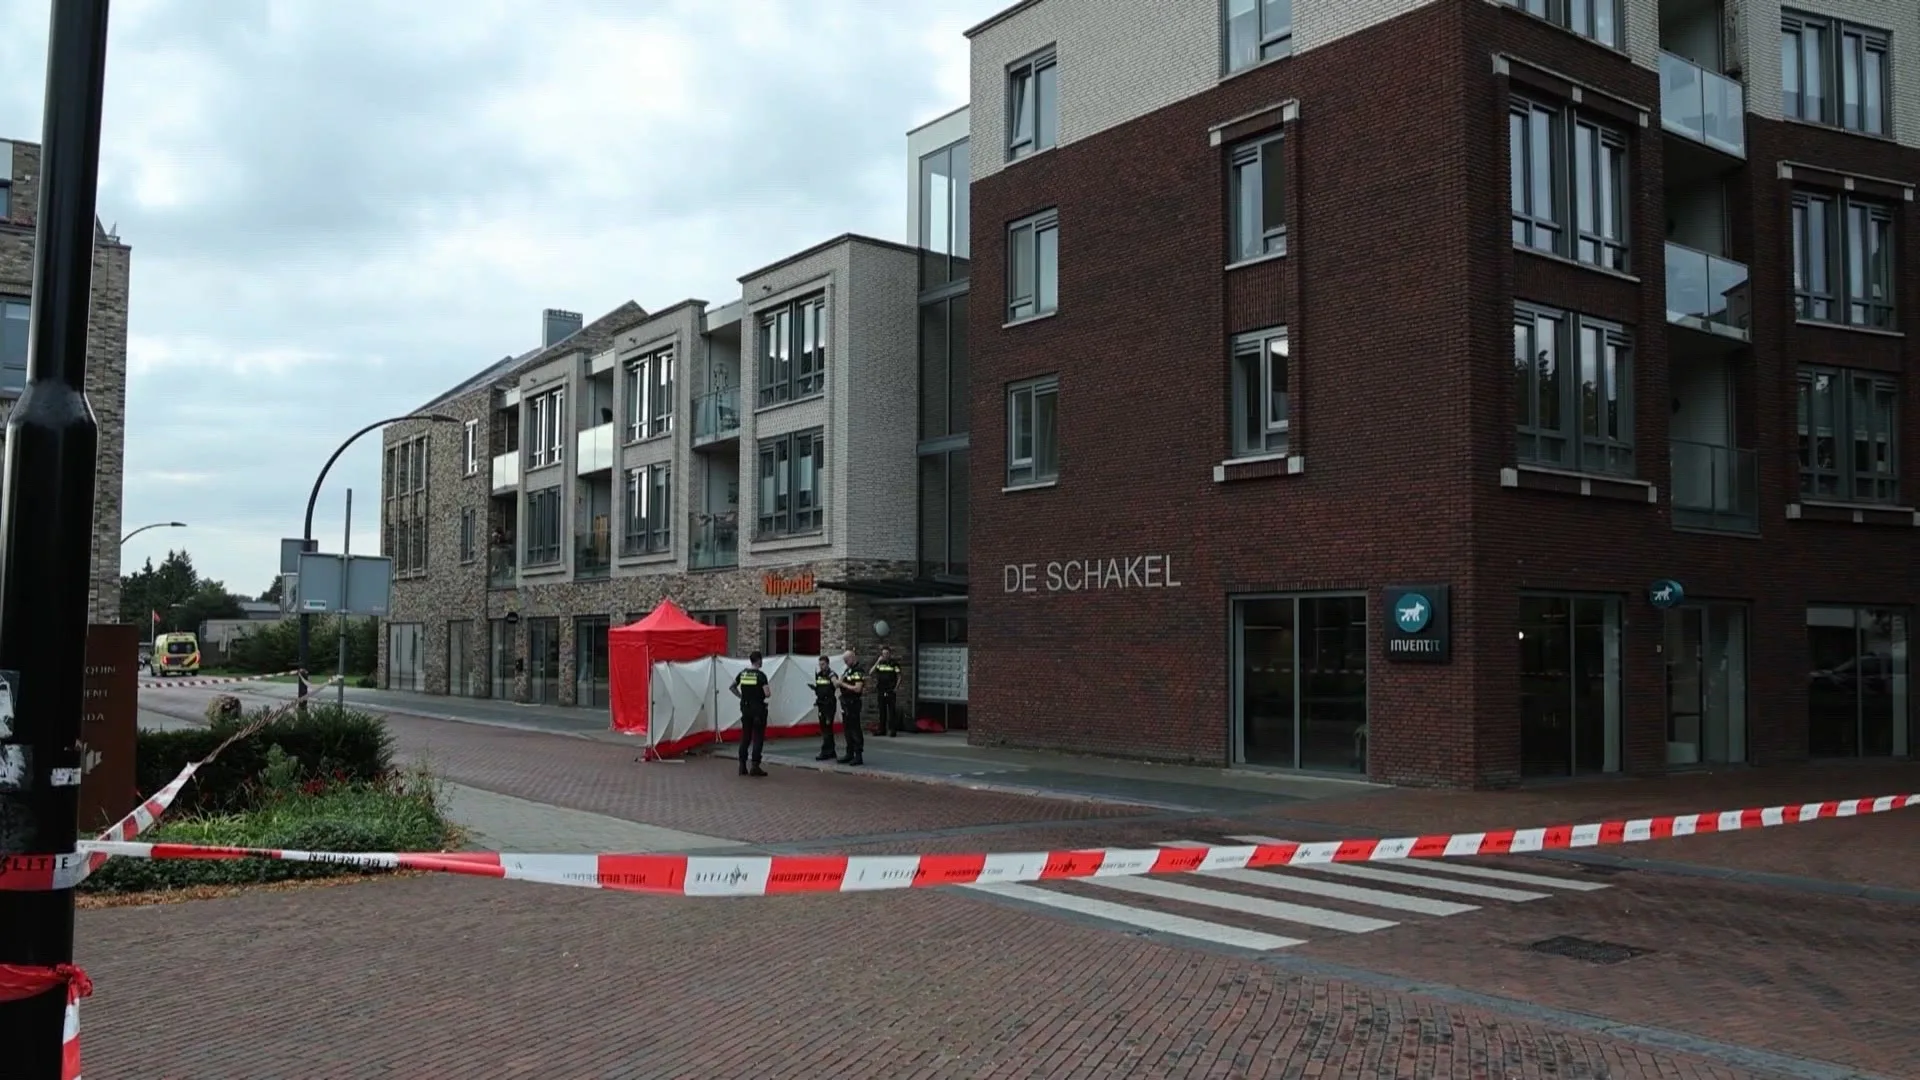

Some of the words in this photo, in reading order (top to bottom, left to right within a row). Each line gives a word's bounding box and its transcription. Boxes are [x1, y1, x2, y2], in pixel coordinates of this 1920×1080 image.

[763, 572, 815, 596] Nijwald
[1003, 563, 1038, 593] DE
[1045, 554, 1182, 592] SCHAKEL
